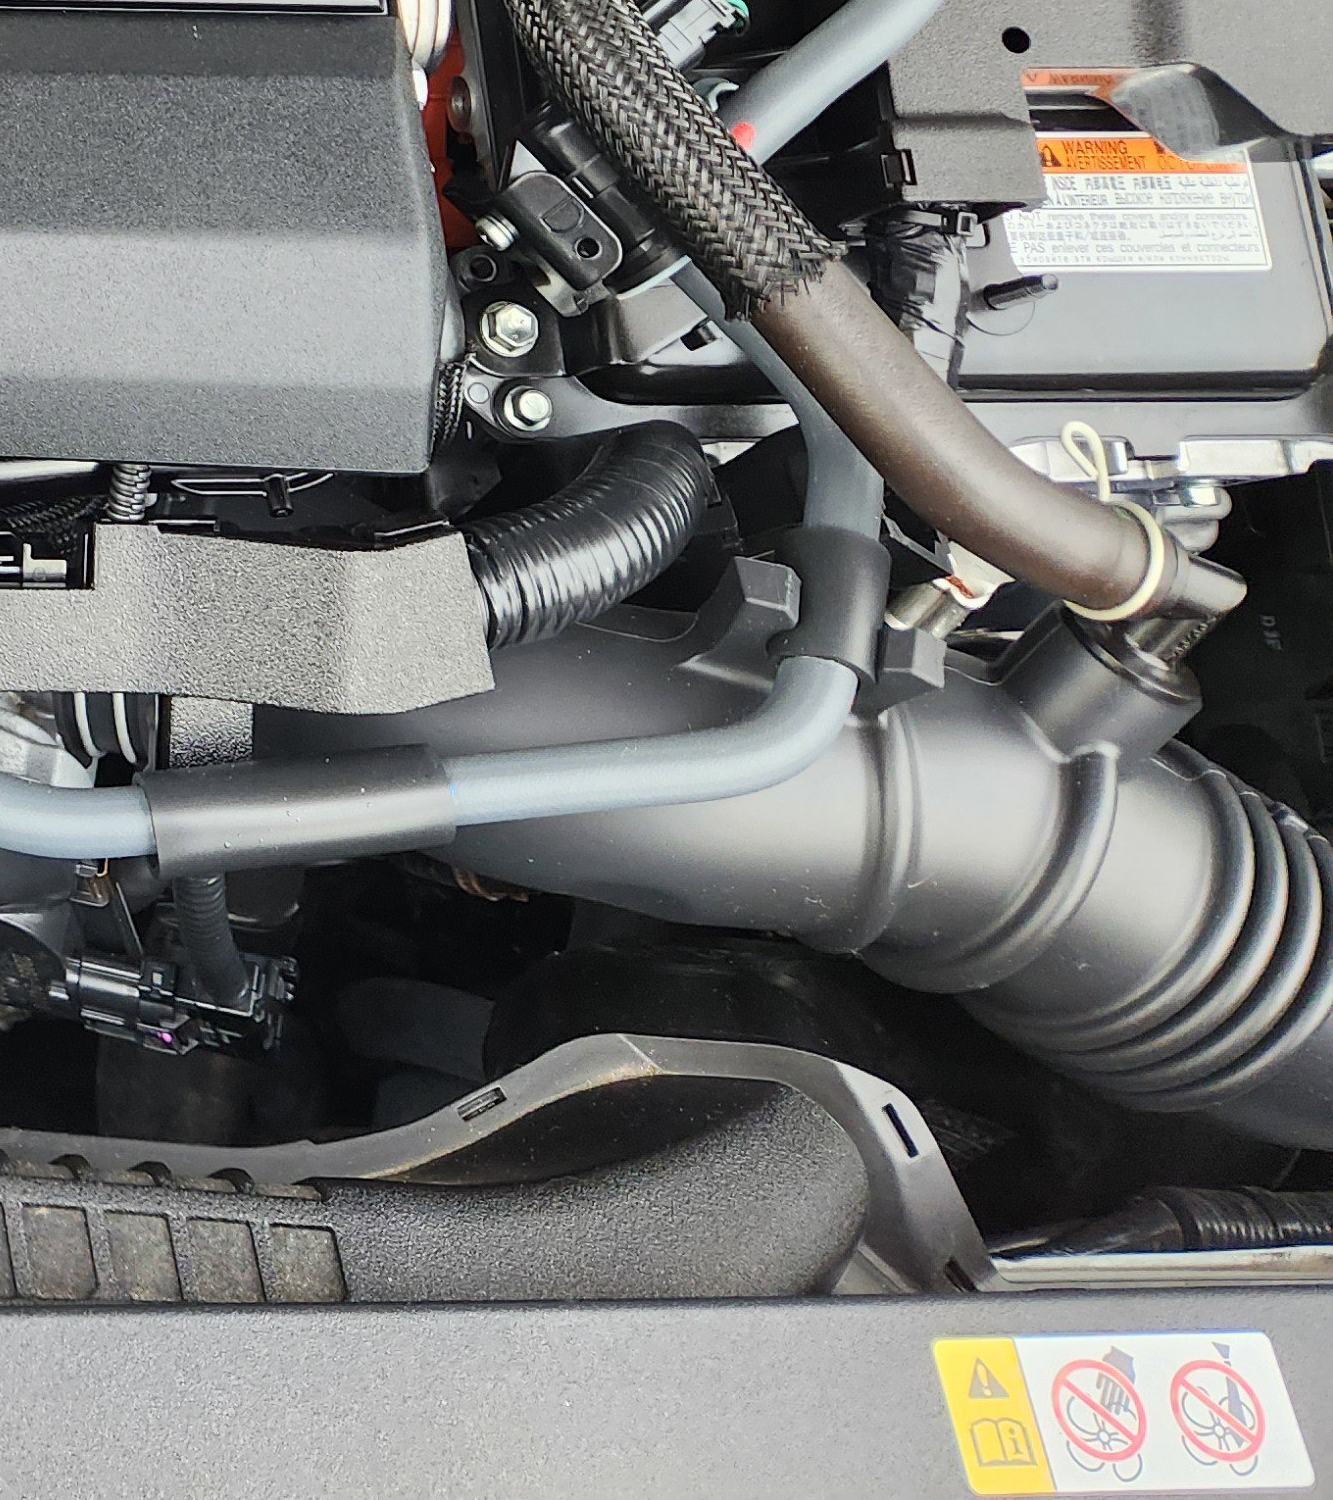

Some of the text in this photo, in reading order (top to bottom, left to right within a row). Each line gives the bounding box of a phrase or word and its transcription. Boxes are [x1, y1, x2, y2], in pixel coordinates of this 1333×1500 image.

[1061, 140, 1128, 155] WARNING
[1065, 155, 1146, 170] AVERTISSEMENT
[1023, 242, 1046, 253] PAS
[1052, 243, 1089, 253] enlever
[1095, 244, 1115, 253] ces
[1181, 243, 1192, 253] et
